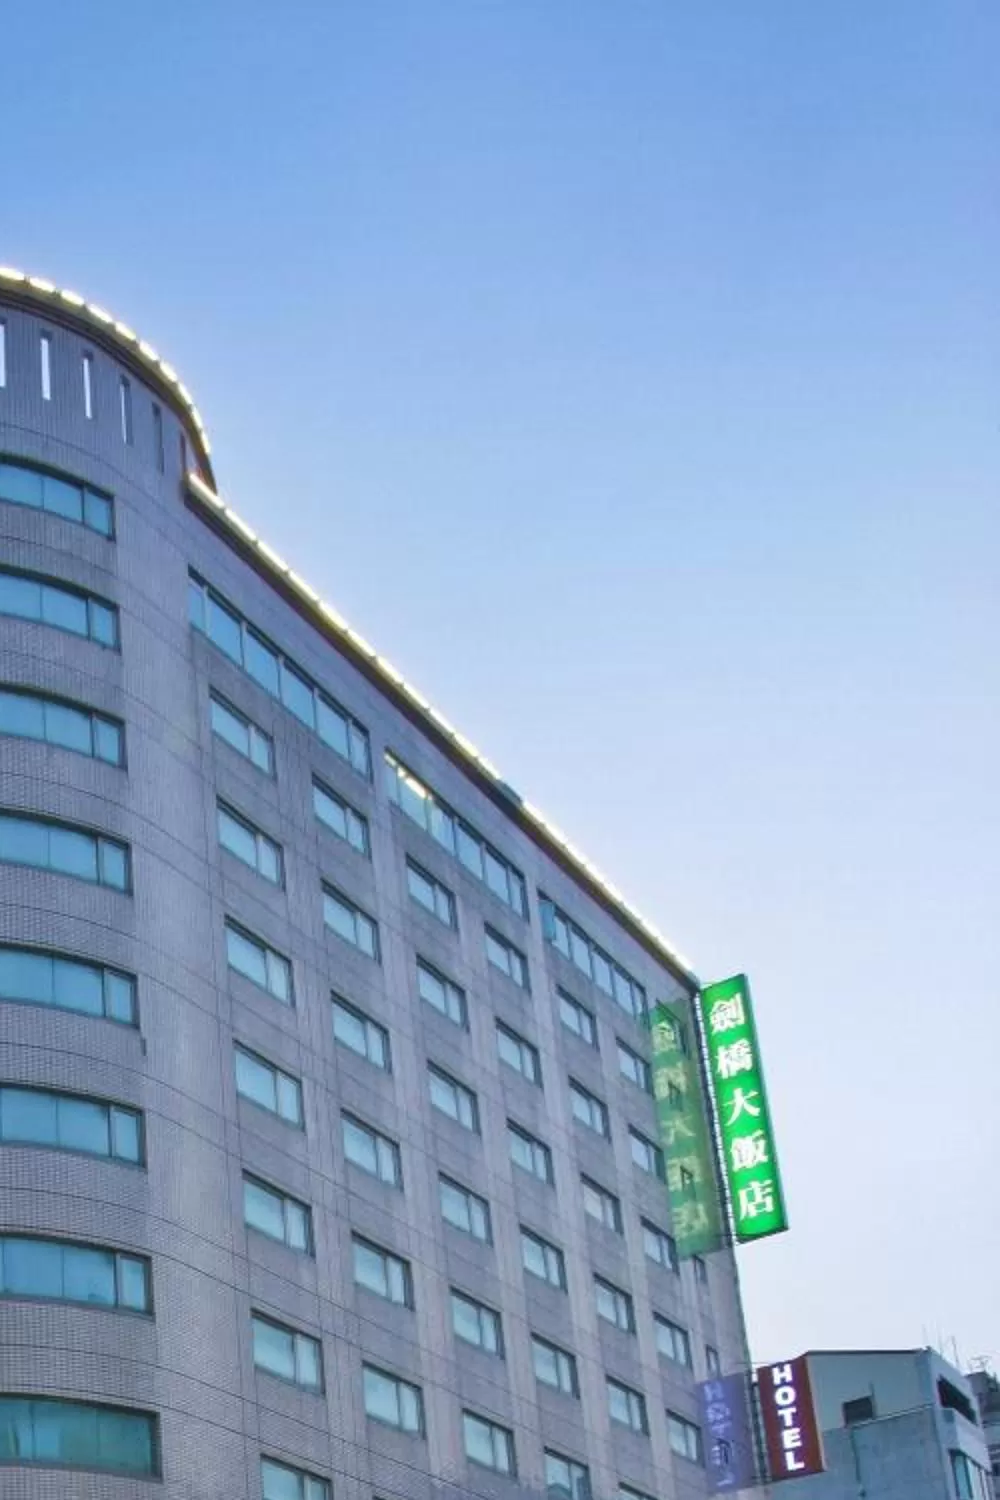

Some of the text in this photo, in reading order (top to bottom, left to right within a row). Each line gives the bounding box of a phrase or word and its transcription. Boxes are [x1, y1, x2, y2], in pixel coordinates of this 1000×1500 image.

[709, 993, 775, 1220] 劍橋大飯店
[772, 1364, 805, 1471] HOTEL
